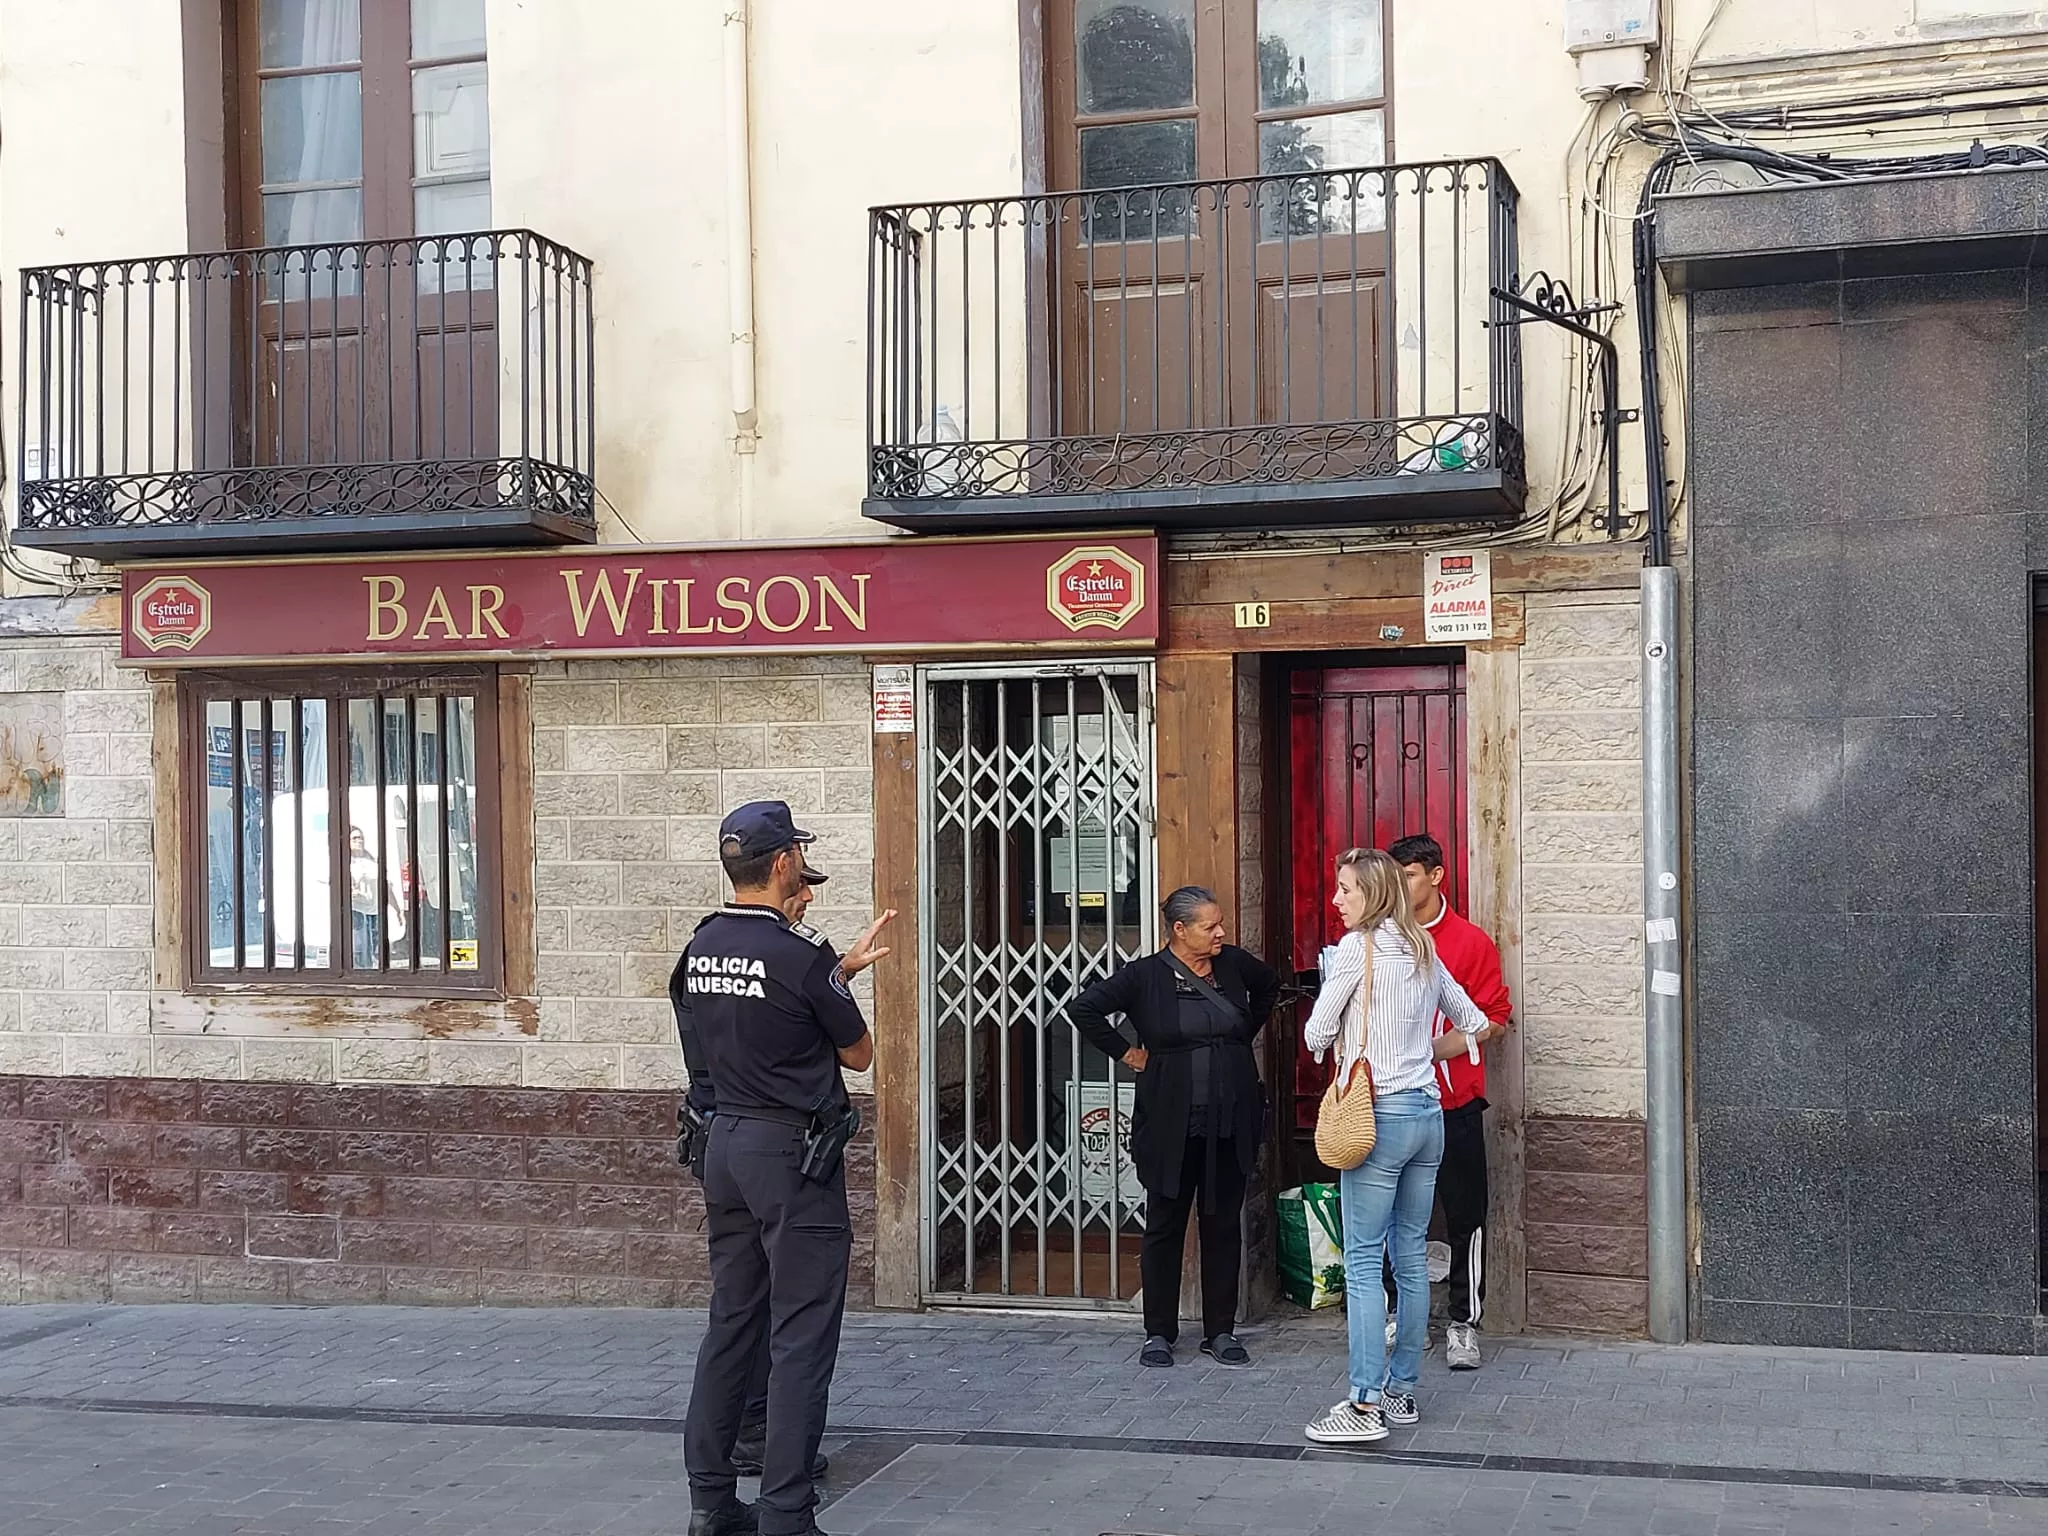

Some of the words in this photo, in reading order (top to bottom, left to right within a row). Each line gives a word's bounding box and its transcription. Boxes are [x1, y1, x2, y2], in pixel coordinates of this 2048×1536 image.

[1066, 575, 1124, 591] Estrella
[1432, 573, 1482, 596] Direct
[1079, 591, 1113, 602] Damm
[148, 601, 194, 616] Estrella
[1429, 600, 1486, 614] ALARMA
[158, 615, 186, 626] Damm
[1240, 605, 1266, 625] 16
[1439, 624, 1453, 632] 902
[1456, 623, 1469, 632] 121
[1473, 622, 1487, 631] 122
[687, 956, 767, 979] POLICIA
[687, 976, 766, 999] HUESCA
